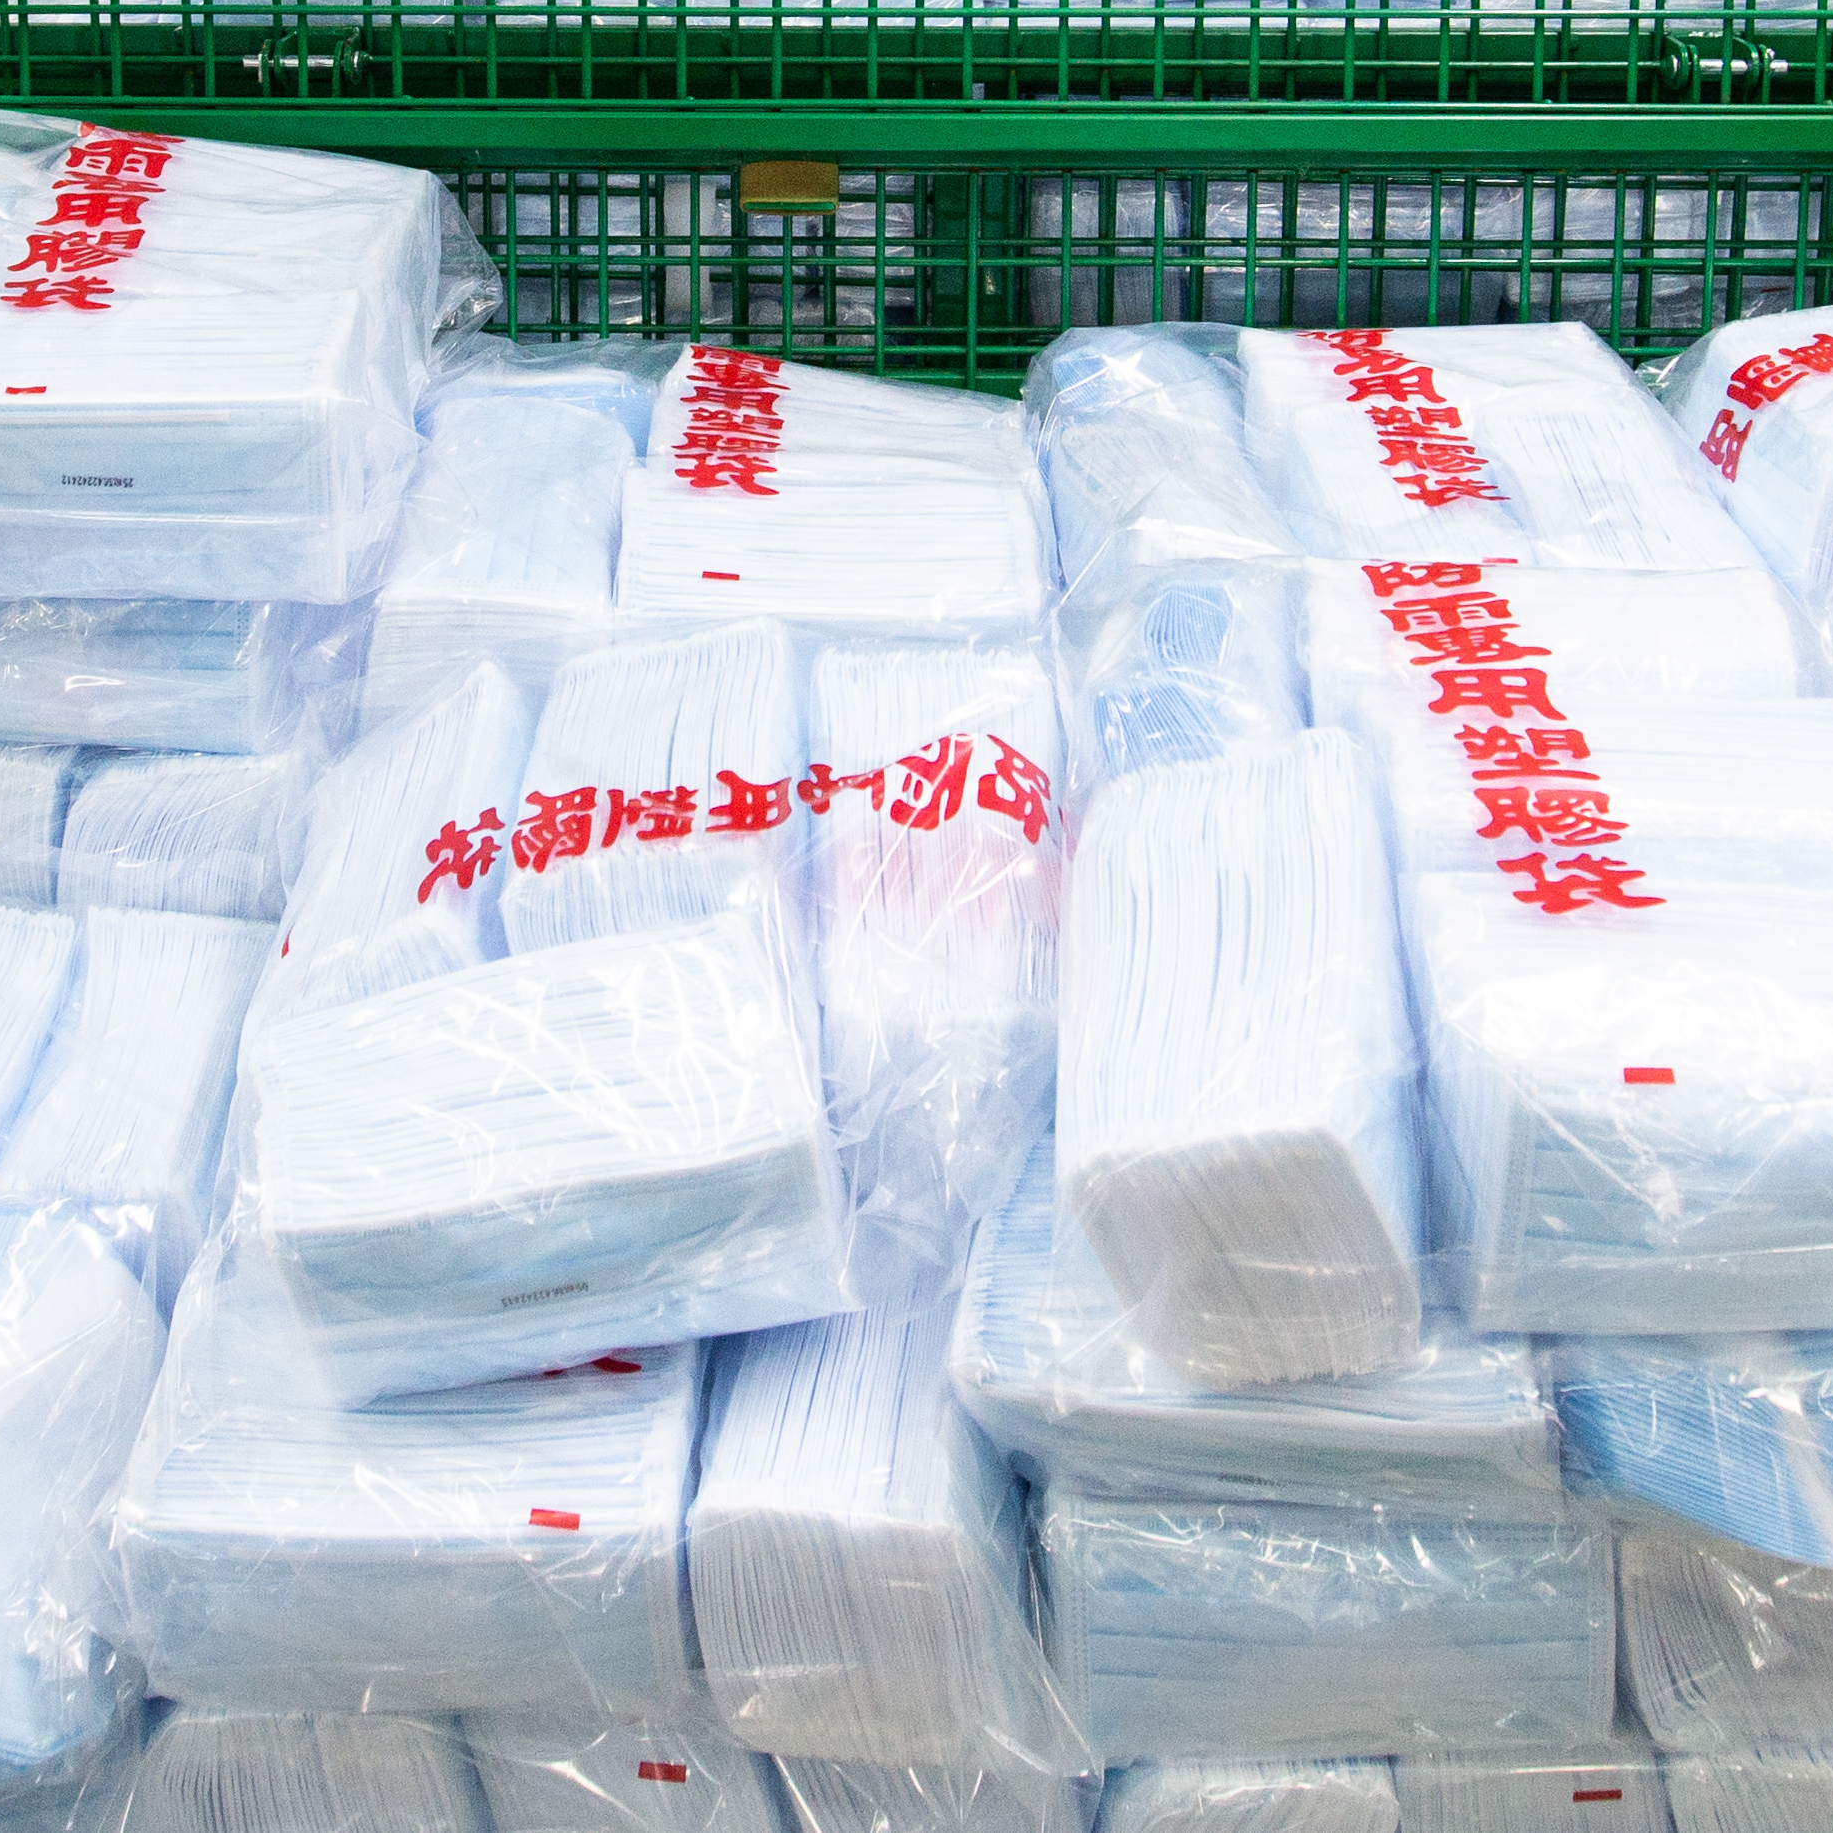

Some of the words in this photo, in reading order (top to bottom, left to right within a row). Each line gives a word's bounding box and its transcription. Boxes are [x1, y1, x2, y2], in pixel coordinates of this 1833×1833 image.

[1361, 561, 1667, 914] 防雨專用塑膠袋
